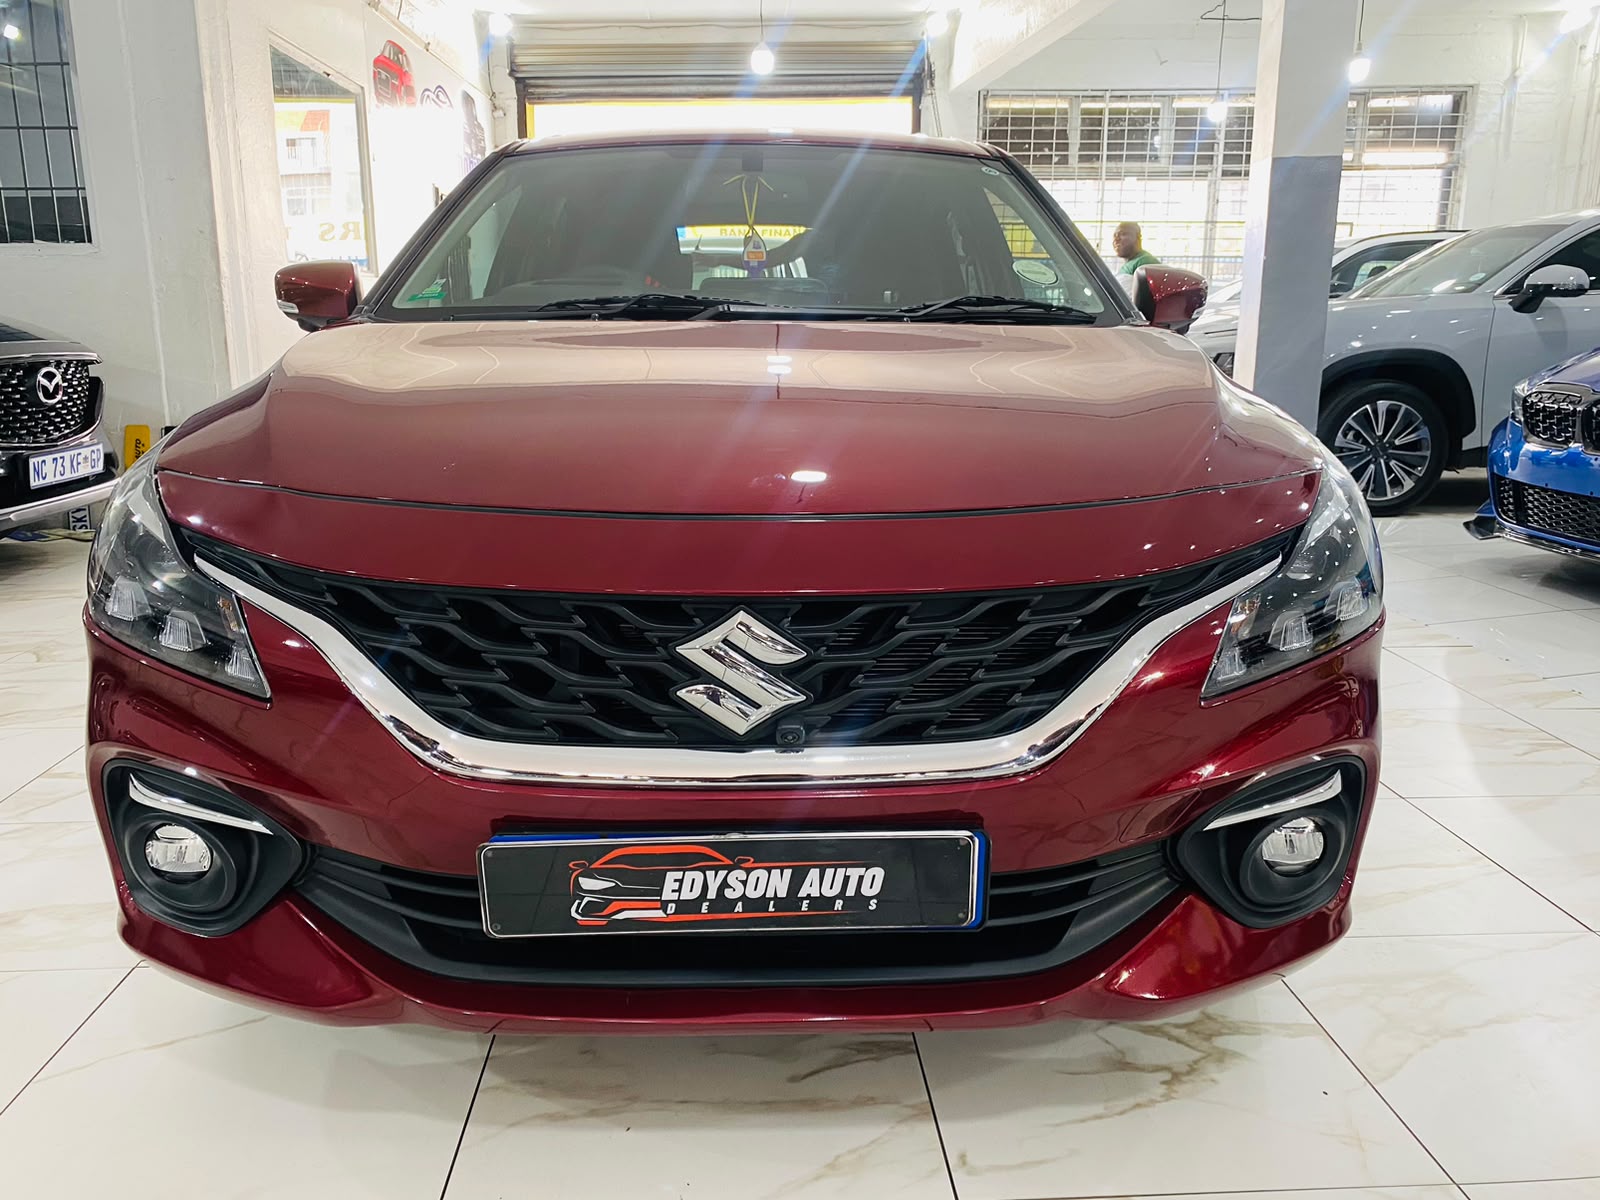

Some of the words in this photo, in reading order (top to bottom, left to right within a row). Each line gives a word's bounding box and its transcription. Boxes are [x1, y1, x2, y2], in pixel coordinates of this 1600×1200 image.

[33, 460, 47, 483] NC
[52, 456, 66, 479] 73
[70, 452, 82, 474] KF
[90, 448, 102, 469] GP
[662, 869, 792, 901] EDYSON
[798, 867, 885, 897] AUTO
[667, 899, 877, 914] DEALERS
